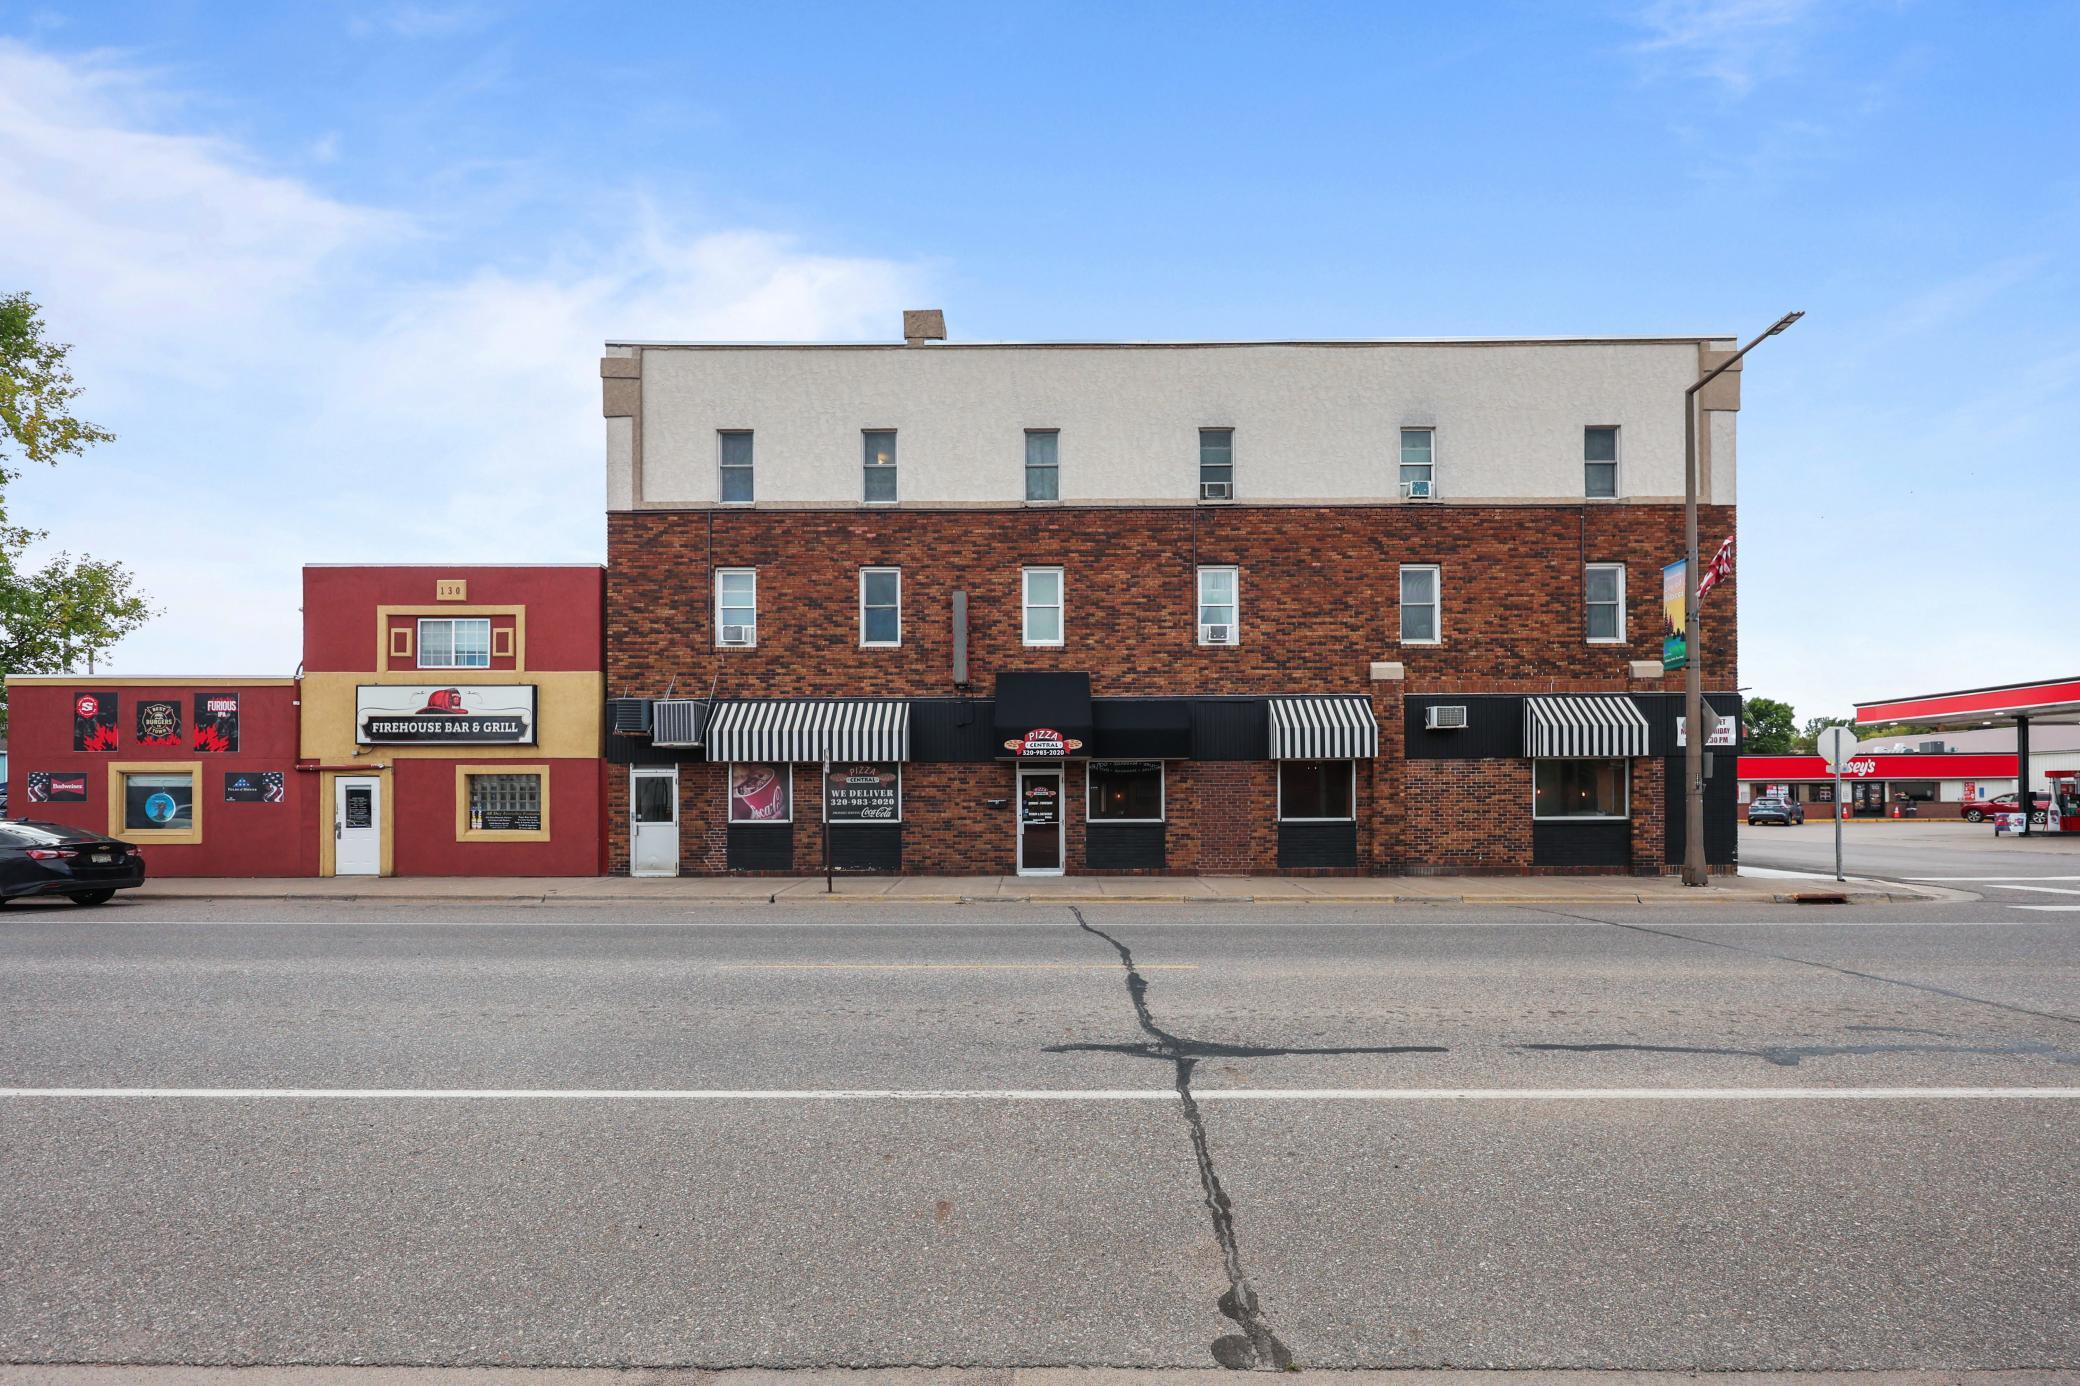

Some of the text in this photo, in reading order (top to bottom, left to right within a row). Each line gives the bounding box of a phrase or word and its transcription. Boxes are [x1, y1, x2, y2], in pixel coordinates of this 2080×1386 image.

[207, 700, 237, 712] FURIOUS
[372, 722, 518, 733] FIREHOUSE BAR & GRILL
[1028, 730, 1058, 741] PIZZA
[1718, 736, 1729, 744] PM
[849, 766, 876, 776] PIZZA
[831, 789, 894, 797] WE DELIVER
[830, 798, 895, 806] 320-983-2020
